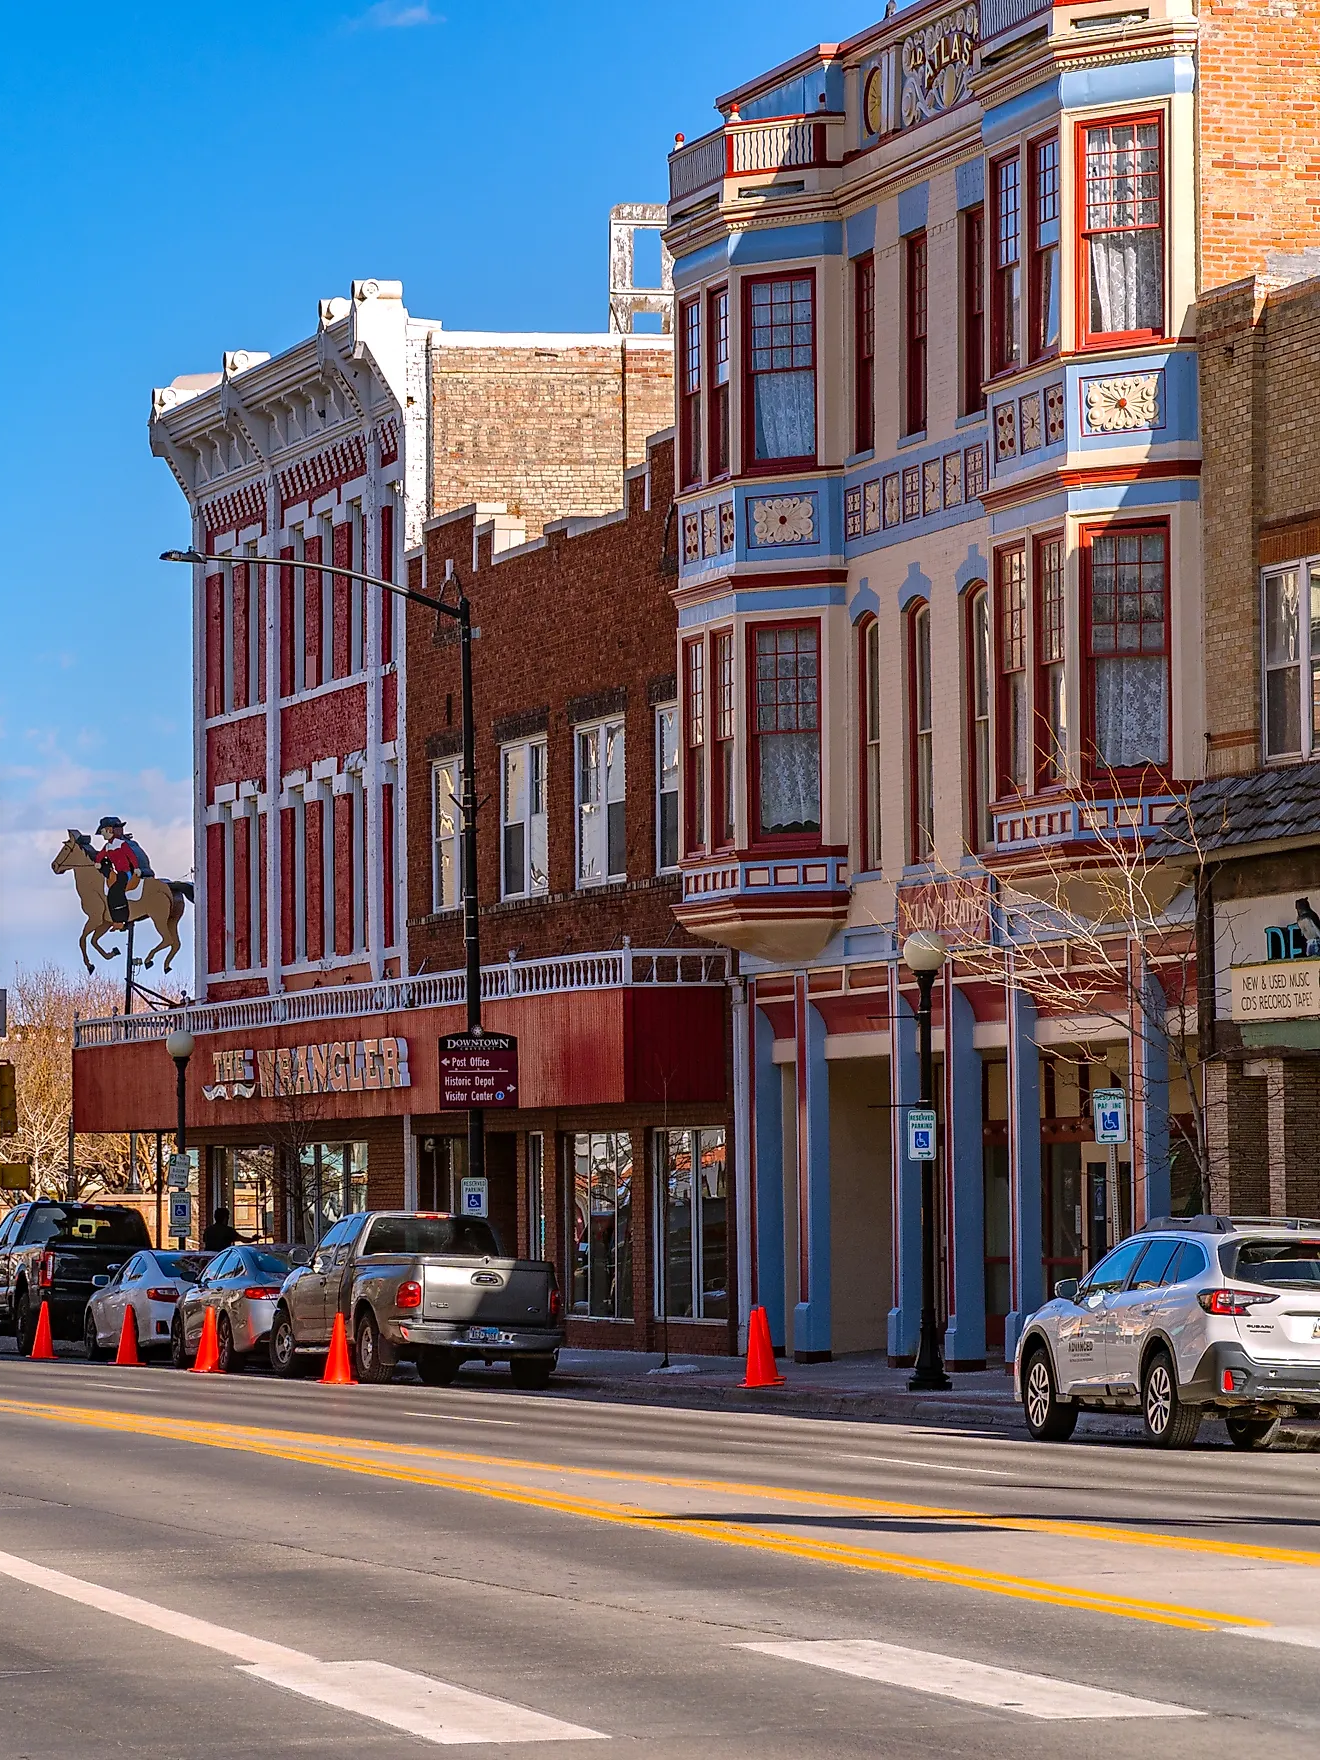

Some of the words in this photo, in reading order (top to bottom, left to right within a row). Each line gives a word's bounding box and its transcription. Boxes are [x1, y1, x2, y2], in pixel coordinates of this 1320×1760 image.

[925, 33, 972, 89] ATLAS
[1242, 976, 1259, 991] NEW
[1262, 975, 1267, 991] &
[1269, 974, 1287, 990] USED
[1289, 971, 1311, 988] MUSIC
[1259, 993, 1292, 1010] RECORDS
[1293, 991, 1313, 1008] TAPES
[447, 1038, 510, 1050] DOWNTOWN
[212, 1049, 253, 1083] THE
[257, 1037, 410, 1098] WRANGLER
[451, 1057, 467, 1067] Post
[469, 1056, 490, 1067] Office
[444, 1075, 472, 1086] Historic
[474, 1075, 495, 1088] Depot
[444, 1090, 467, 1102] Visitor
[471, 1090, 493, 1101] Center
[1097, 1102, 1122, 1110] PARING
